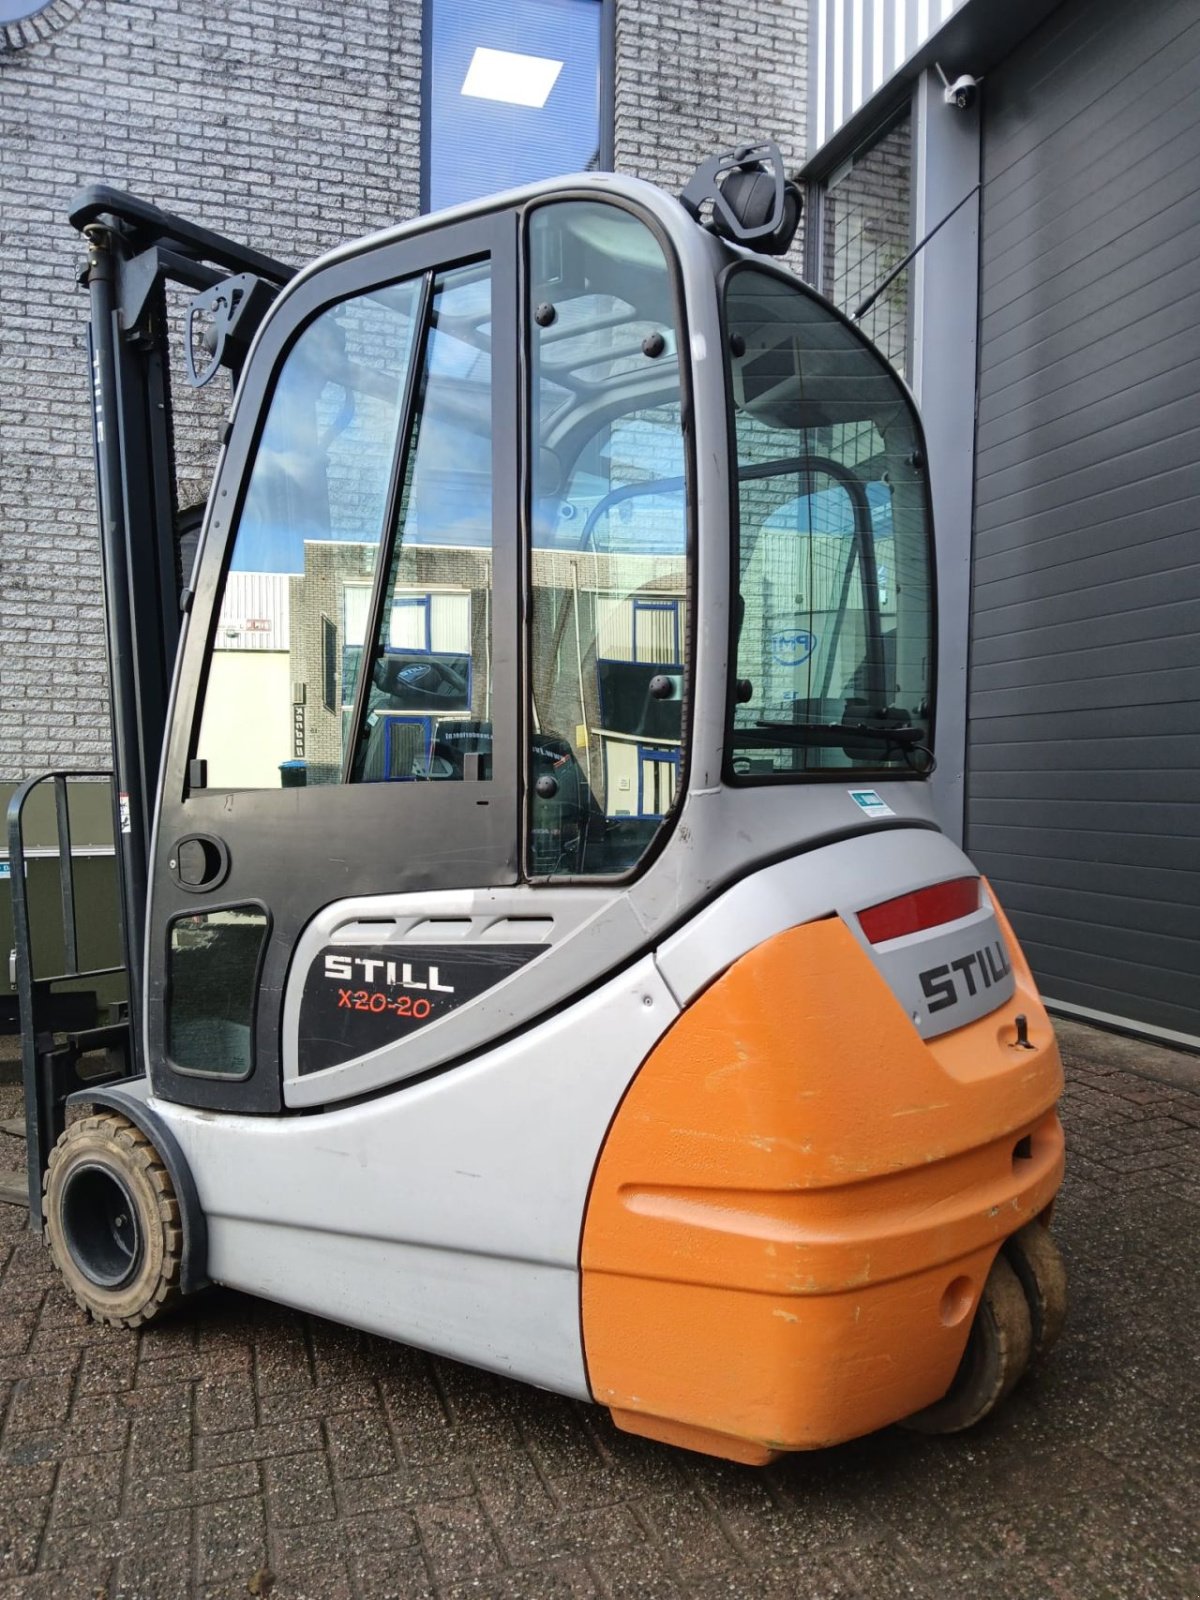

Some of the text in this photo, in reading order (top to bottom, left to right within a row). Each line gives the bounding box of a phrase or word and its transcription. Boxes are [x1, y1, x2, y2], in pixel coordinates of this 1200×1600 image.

[399, 666, 428, 678] STILL
[324, 955, 455, 993] STILL
[918, 941, 1011, 1014] STILL
[338, 988, 431, 1018] X20-20
